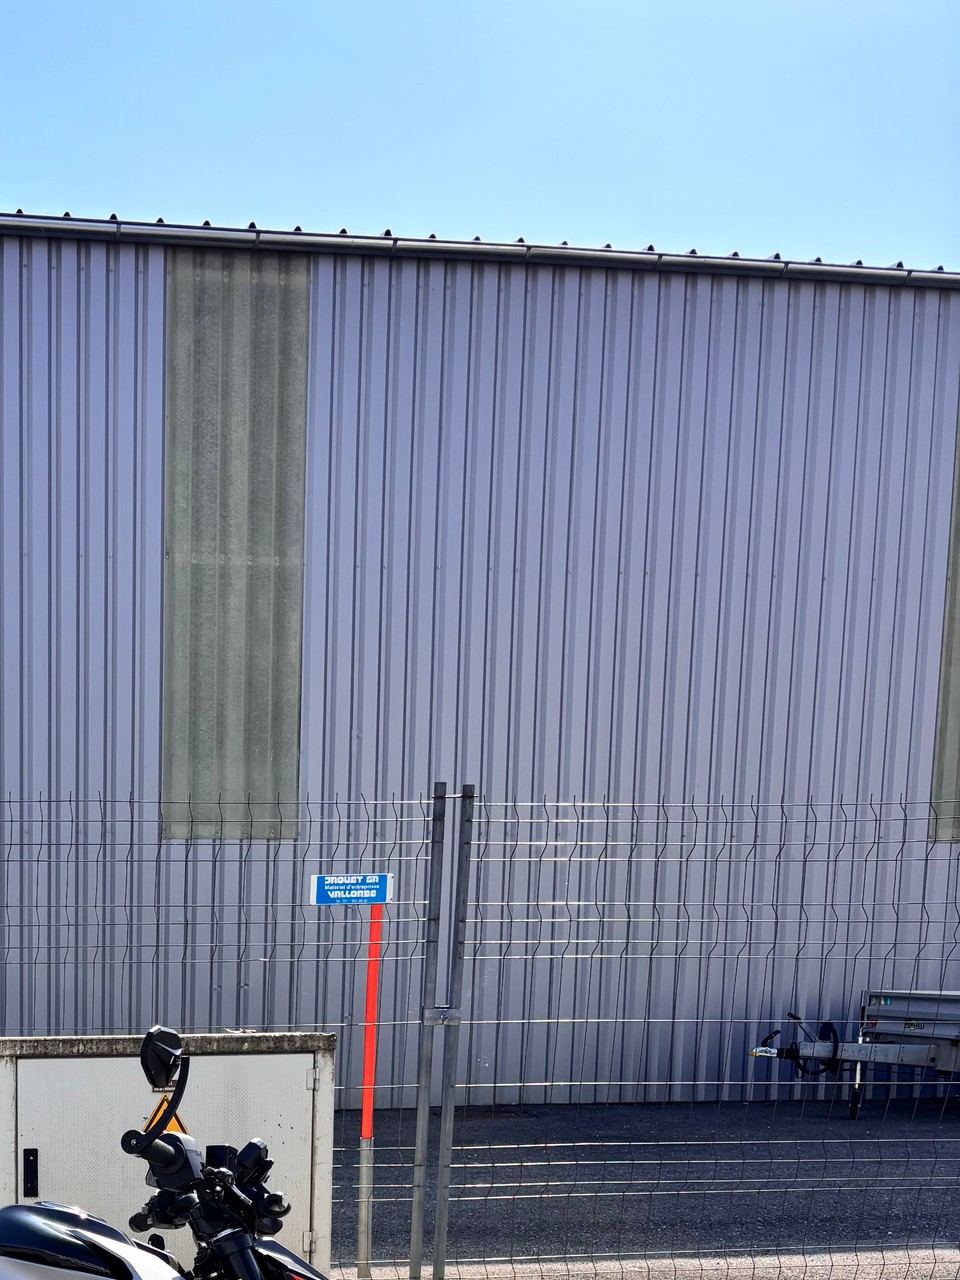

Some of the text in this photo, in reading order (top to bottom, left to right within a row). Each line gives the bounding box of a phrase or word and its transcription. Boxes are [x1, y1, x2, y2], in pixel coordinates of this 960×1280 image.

[324, 875, 379, 884] JAQUET SA
[327, 890, 377, 898] VALLORBE
